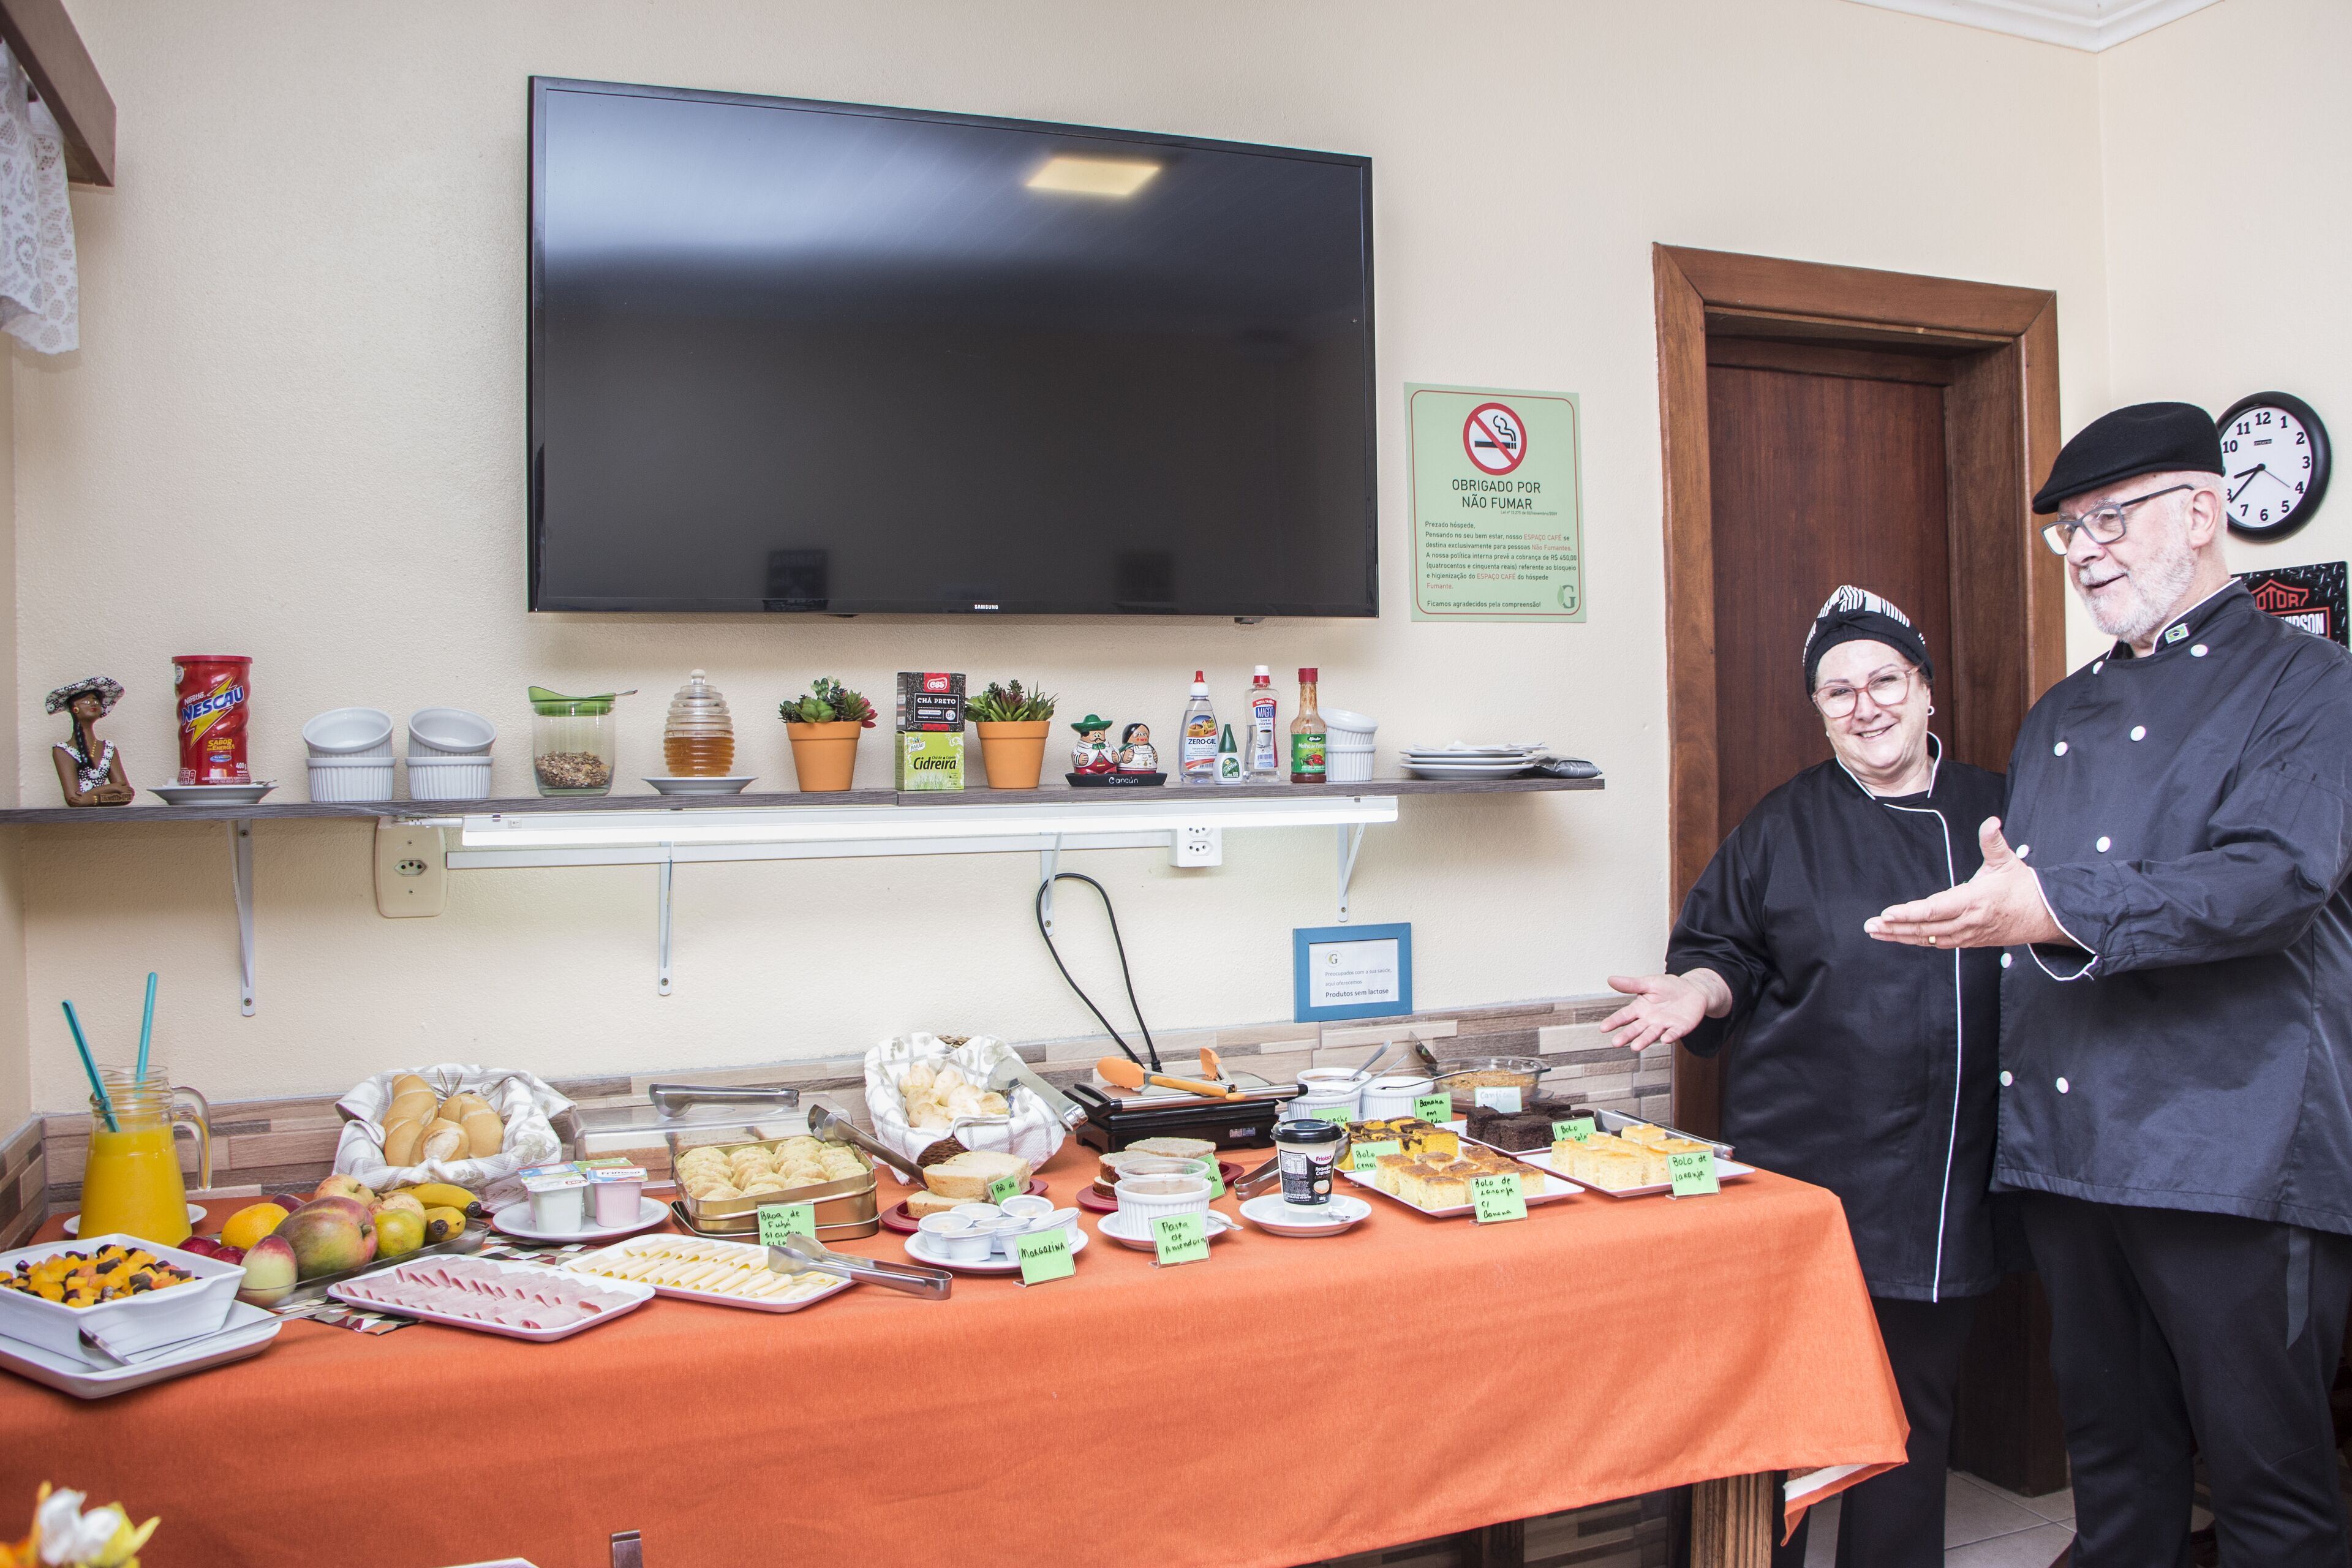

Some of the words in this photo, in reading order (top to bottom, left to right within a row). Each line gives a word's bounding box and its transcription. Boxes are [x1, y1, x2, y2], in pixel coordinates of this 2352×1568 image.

[2255, 412, 2271, 425] 12
[2281, 416, 2288, 428] 1
[2237, 422, 2250, 435] 11
[2296, 432, 2305, 445] 2
[2223, 440, 2237, 453] 10
[2302, 456, 2310, 469] 3
[1452, 479, 1513, 492] OBRIGADO
[1518, 482, 1540, 493] POR
[2295, 481, 2304, 494] 4
[1462, 494, 1487, 508] NÃO
[1491, 497, 1532, 510] FUMAR
[2282, 500, 2290, 513] 5
[2241, 504, 2248, 516] 7
[2260, 509, 2268, 521] 6
[1562, 585, 1576, 609] G
[2256, 586, 2299, 610] OTOR
[184, 692, 205, 705] Nestlé
[182, 685, 244, 726] NESCAU
[1257, 707, 1274, 718] MAGRO
[208, 739, 233, 747] SABOR
[913, 756, 957, 770] Cidreira
[1331, 954, 1338, 964] G
[1161, 1221, 1189, 1234] Pasta
